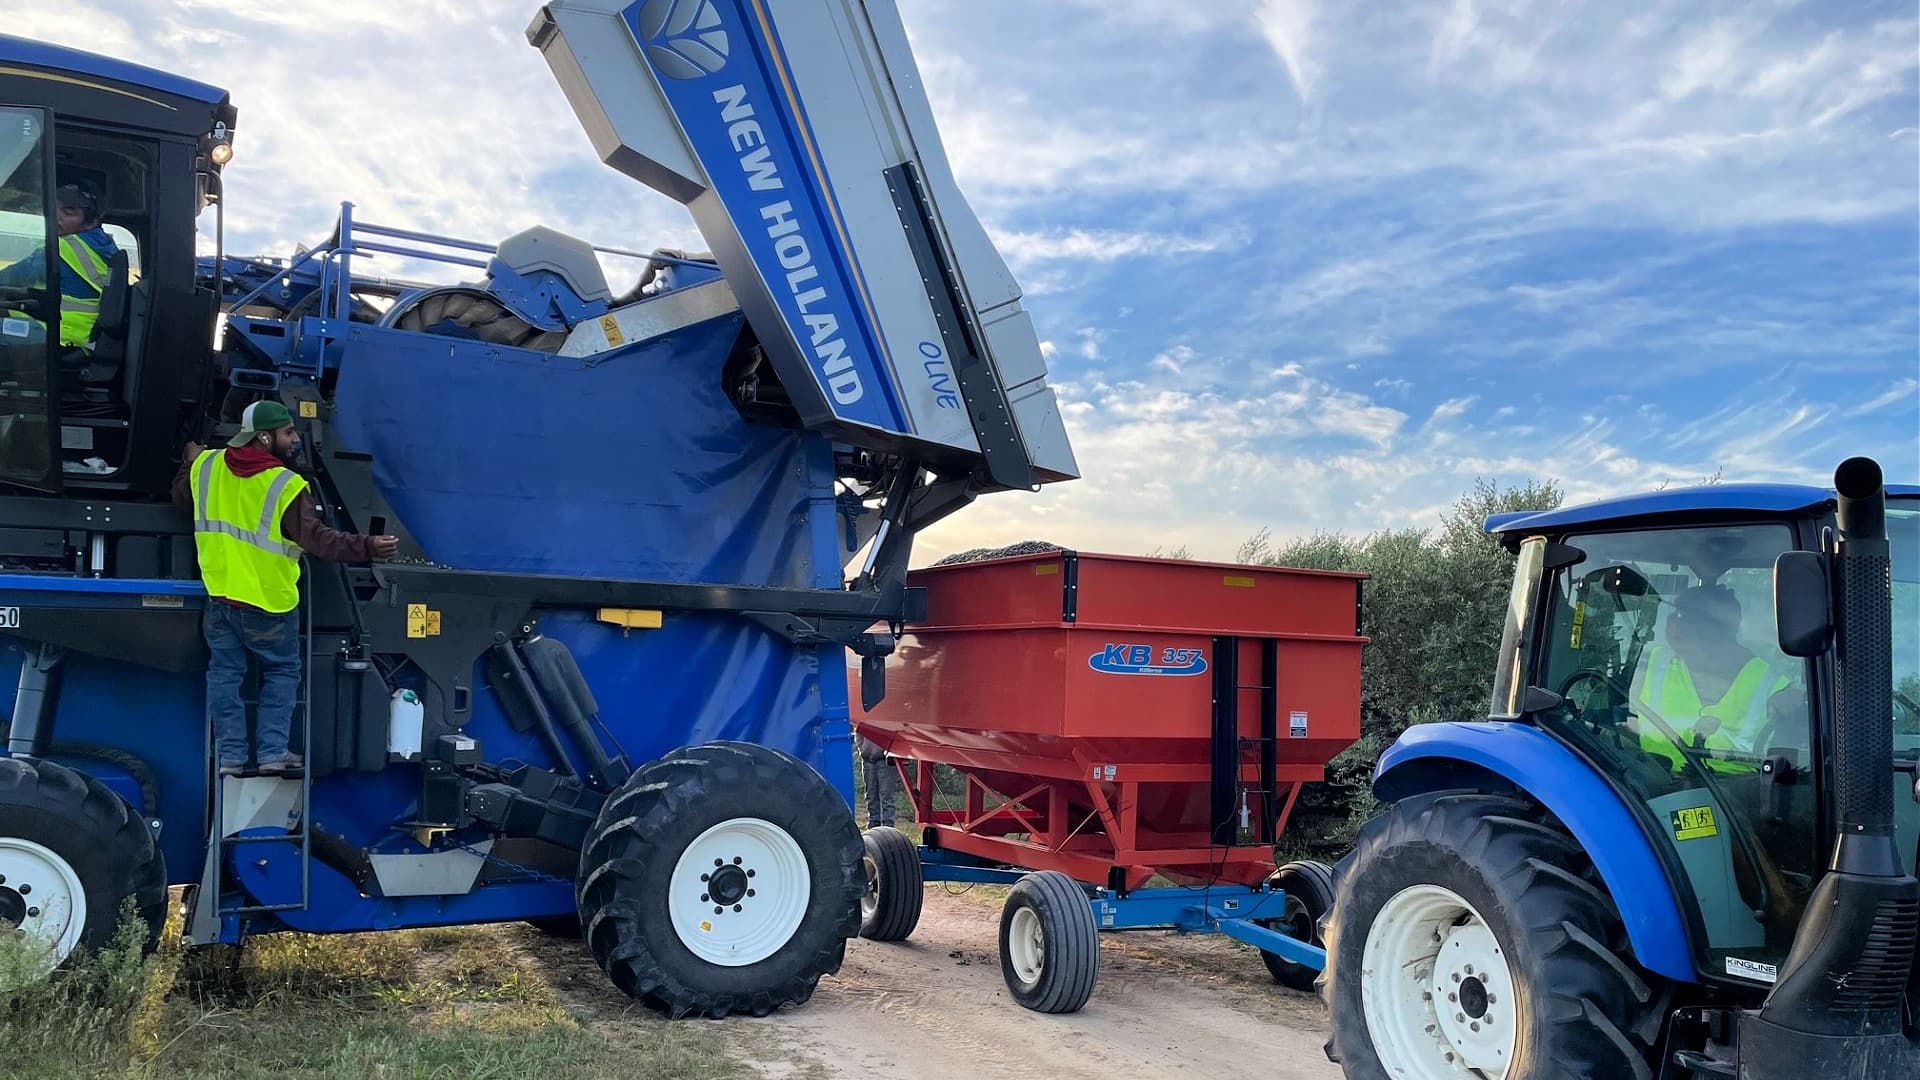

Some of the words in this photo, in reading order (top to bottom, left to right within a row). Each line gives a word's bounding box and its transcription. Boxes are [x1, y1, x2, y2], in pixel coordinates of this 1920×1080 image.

[712, 84, 784, 191] NEW
[759, 200, 864, 405] HOLLAND
[918, 341, 960, 409] OLIVE
[1102, 643, 1152, 666] KB
[1162, 647, 1203, 664] 357
[1727, 959, 1776, 973] KINGLINE
